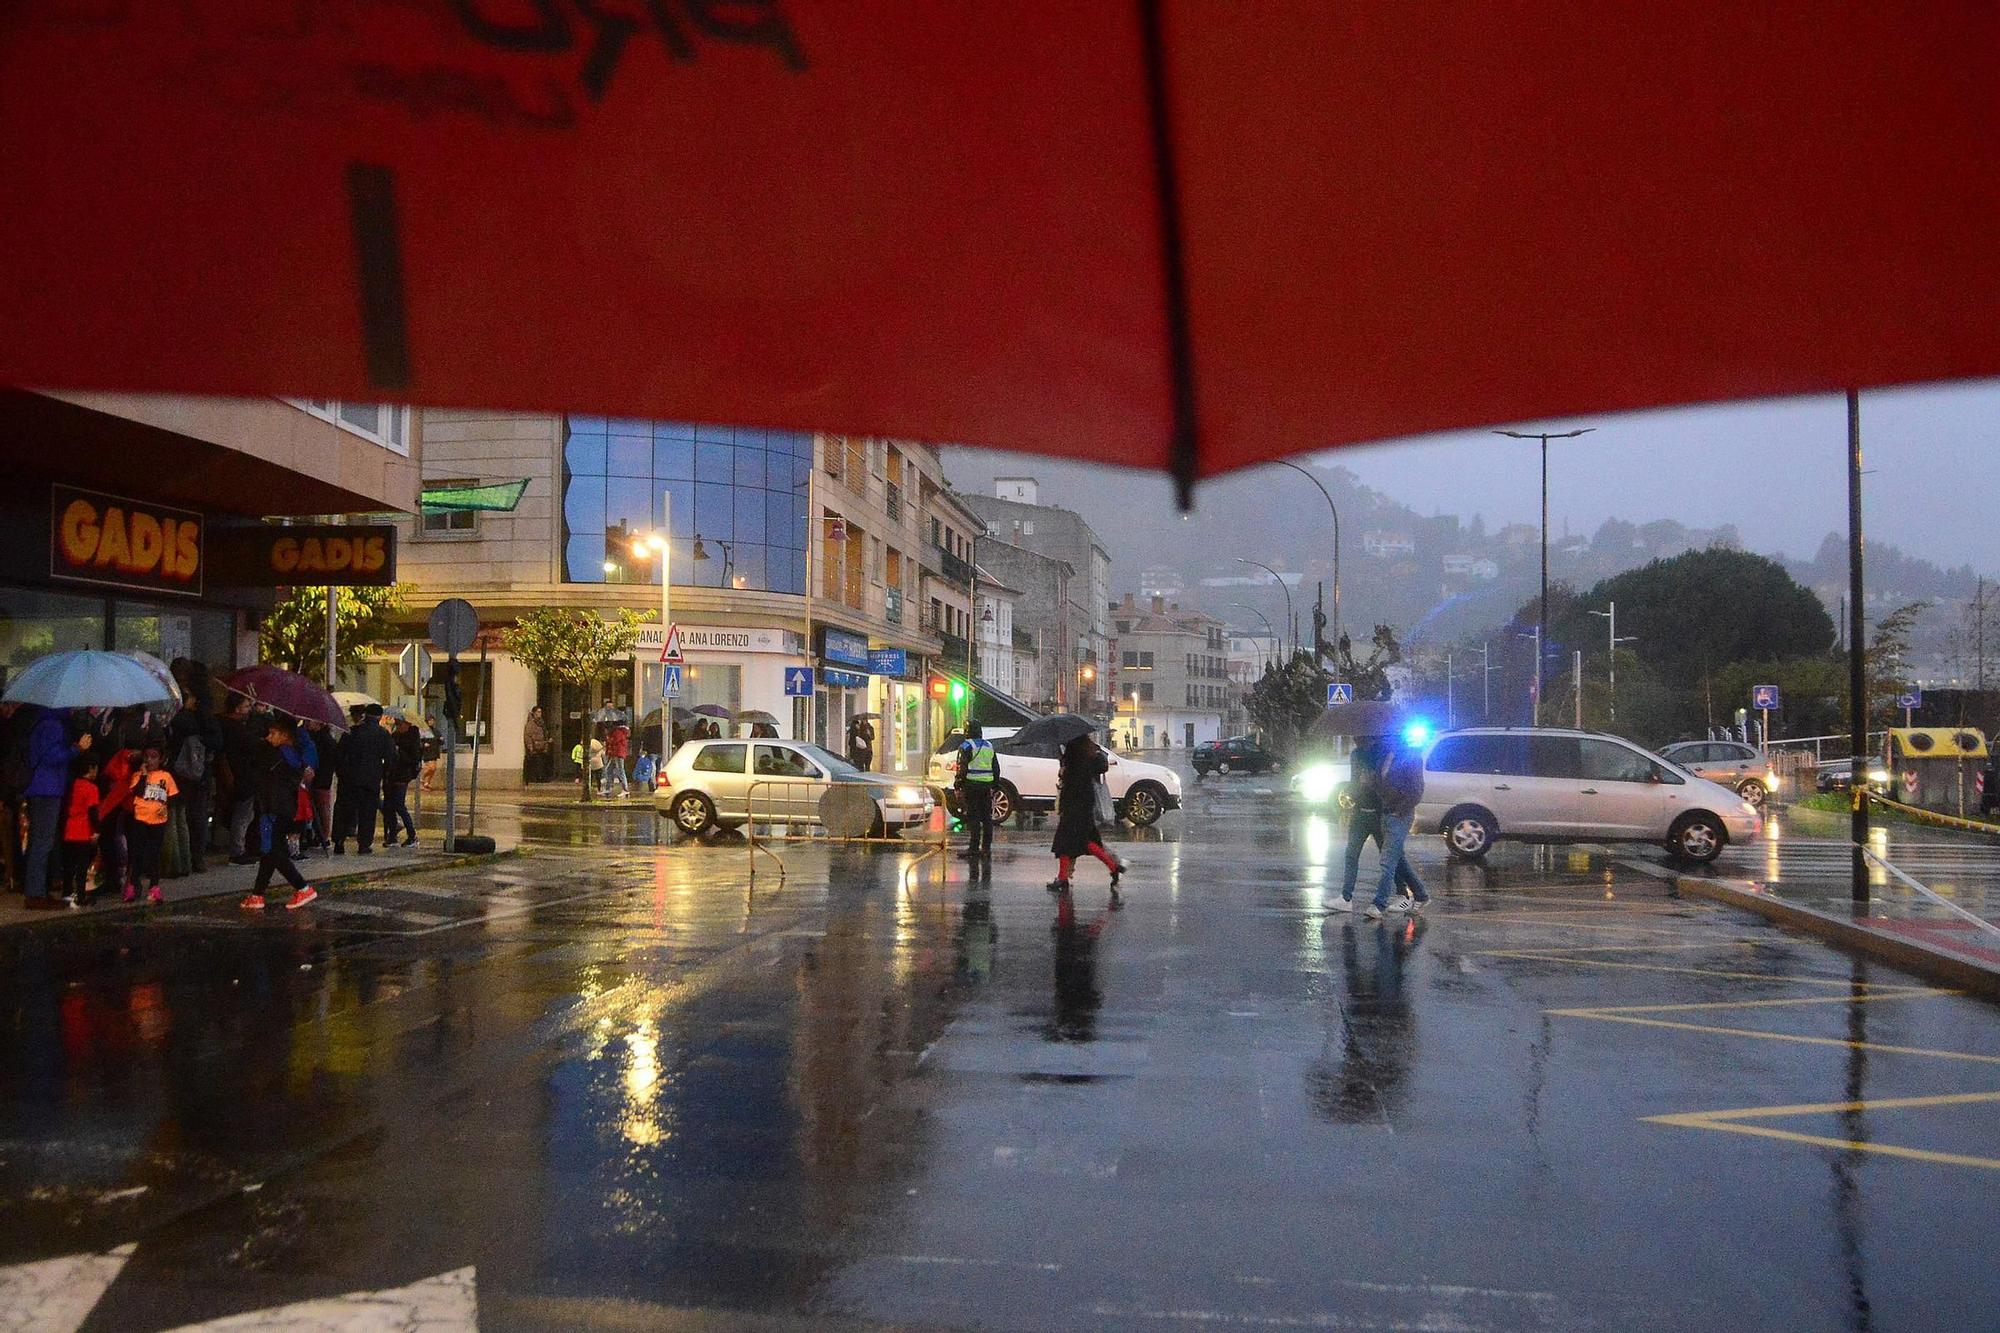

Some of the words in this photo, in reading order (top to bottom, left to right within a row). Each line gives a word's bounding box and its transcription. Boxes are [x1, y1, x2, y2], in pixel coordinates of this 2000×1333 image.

[62, 500, 199, 582] GADIS
[270, 537, 386, 572] GADIS
[688, 632, 707, 646] ANA
[709, 634, 749, 647] LORENZO
